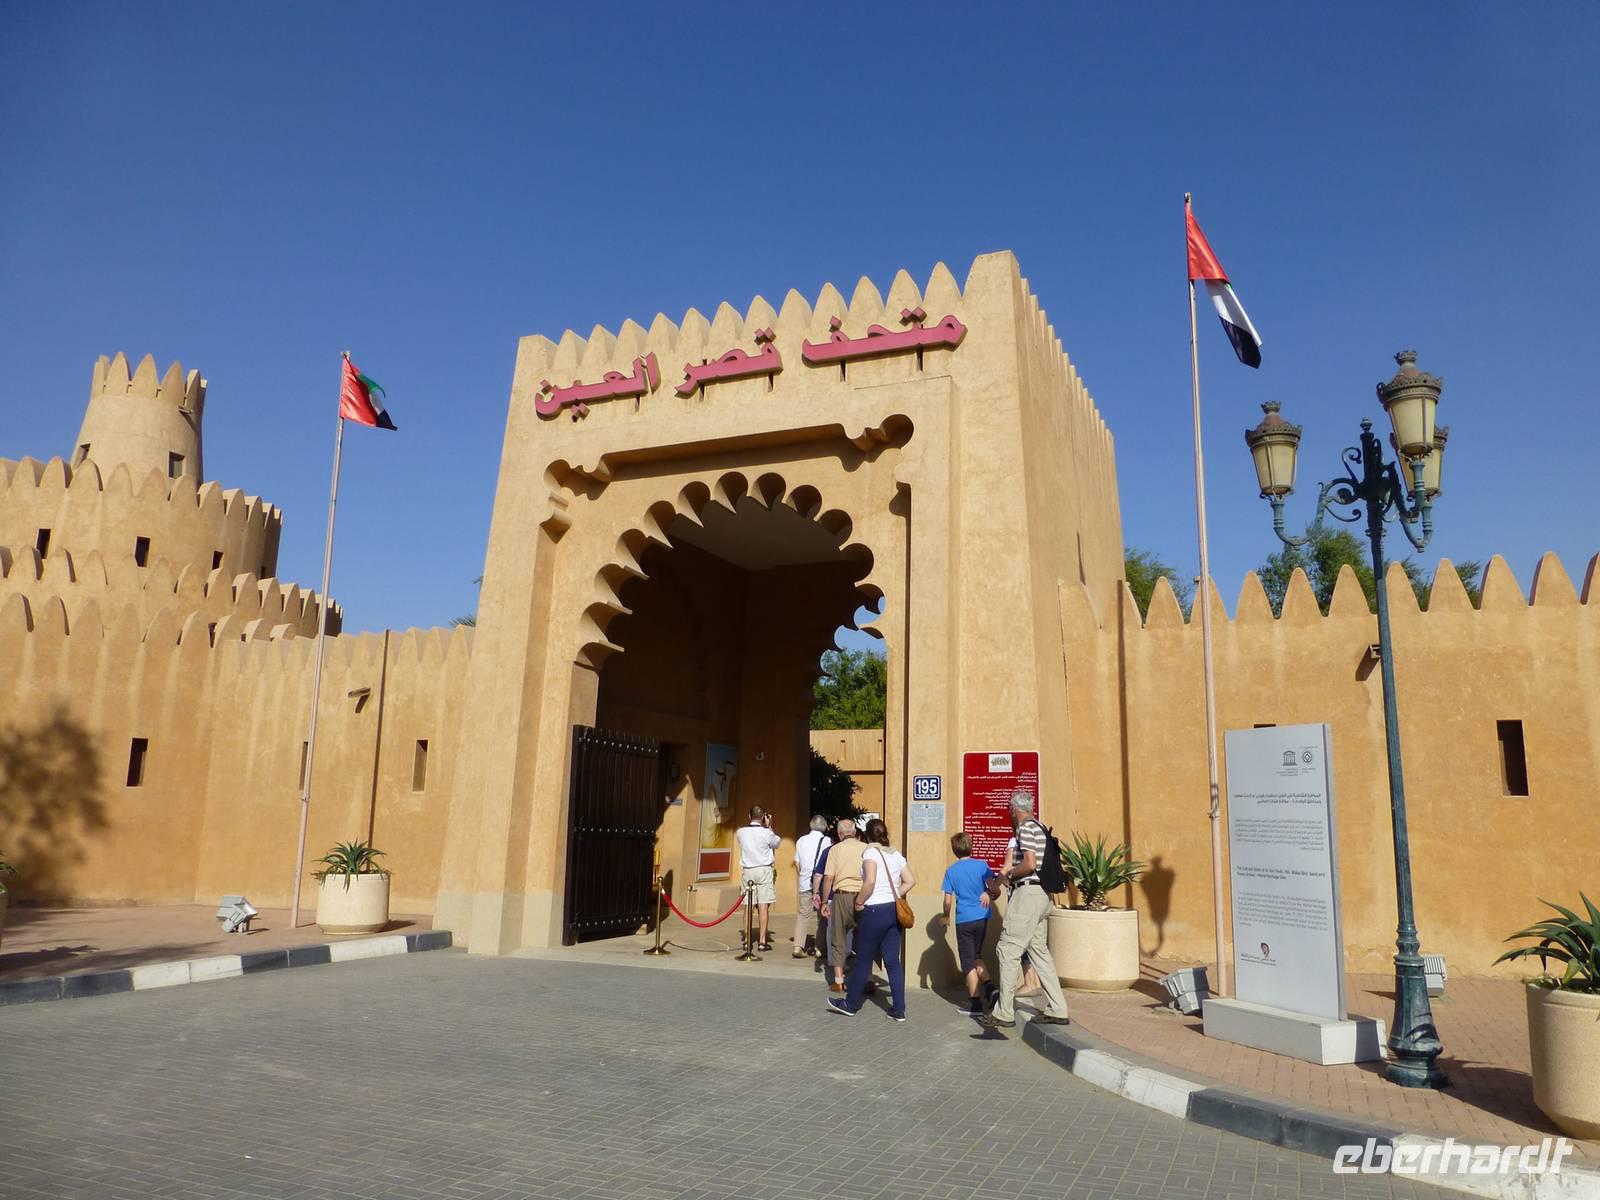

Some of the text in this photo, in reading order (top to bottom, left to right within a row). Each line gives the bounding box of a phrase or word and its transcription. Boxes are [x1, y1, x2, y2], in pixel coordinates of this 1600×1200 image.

[535, 307, 968, 421] متحف قصر العين
[916, 779, 937, 794] 195
